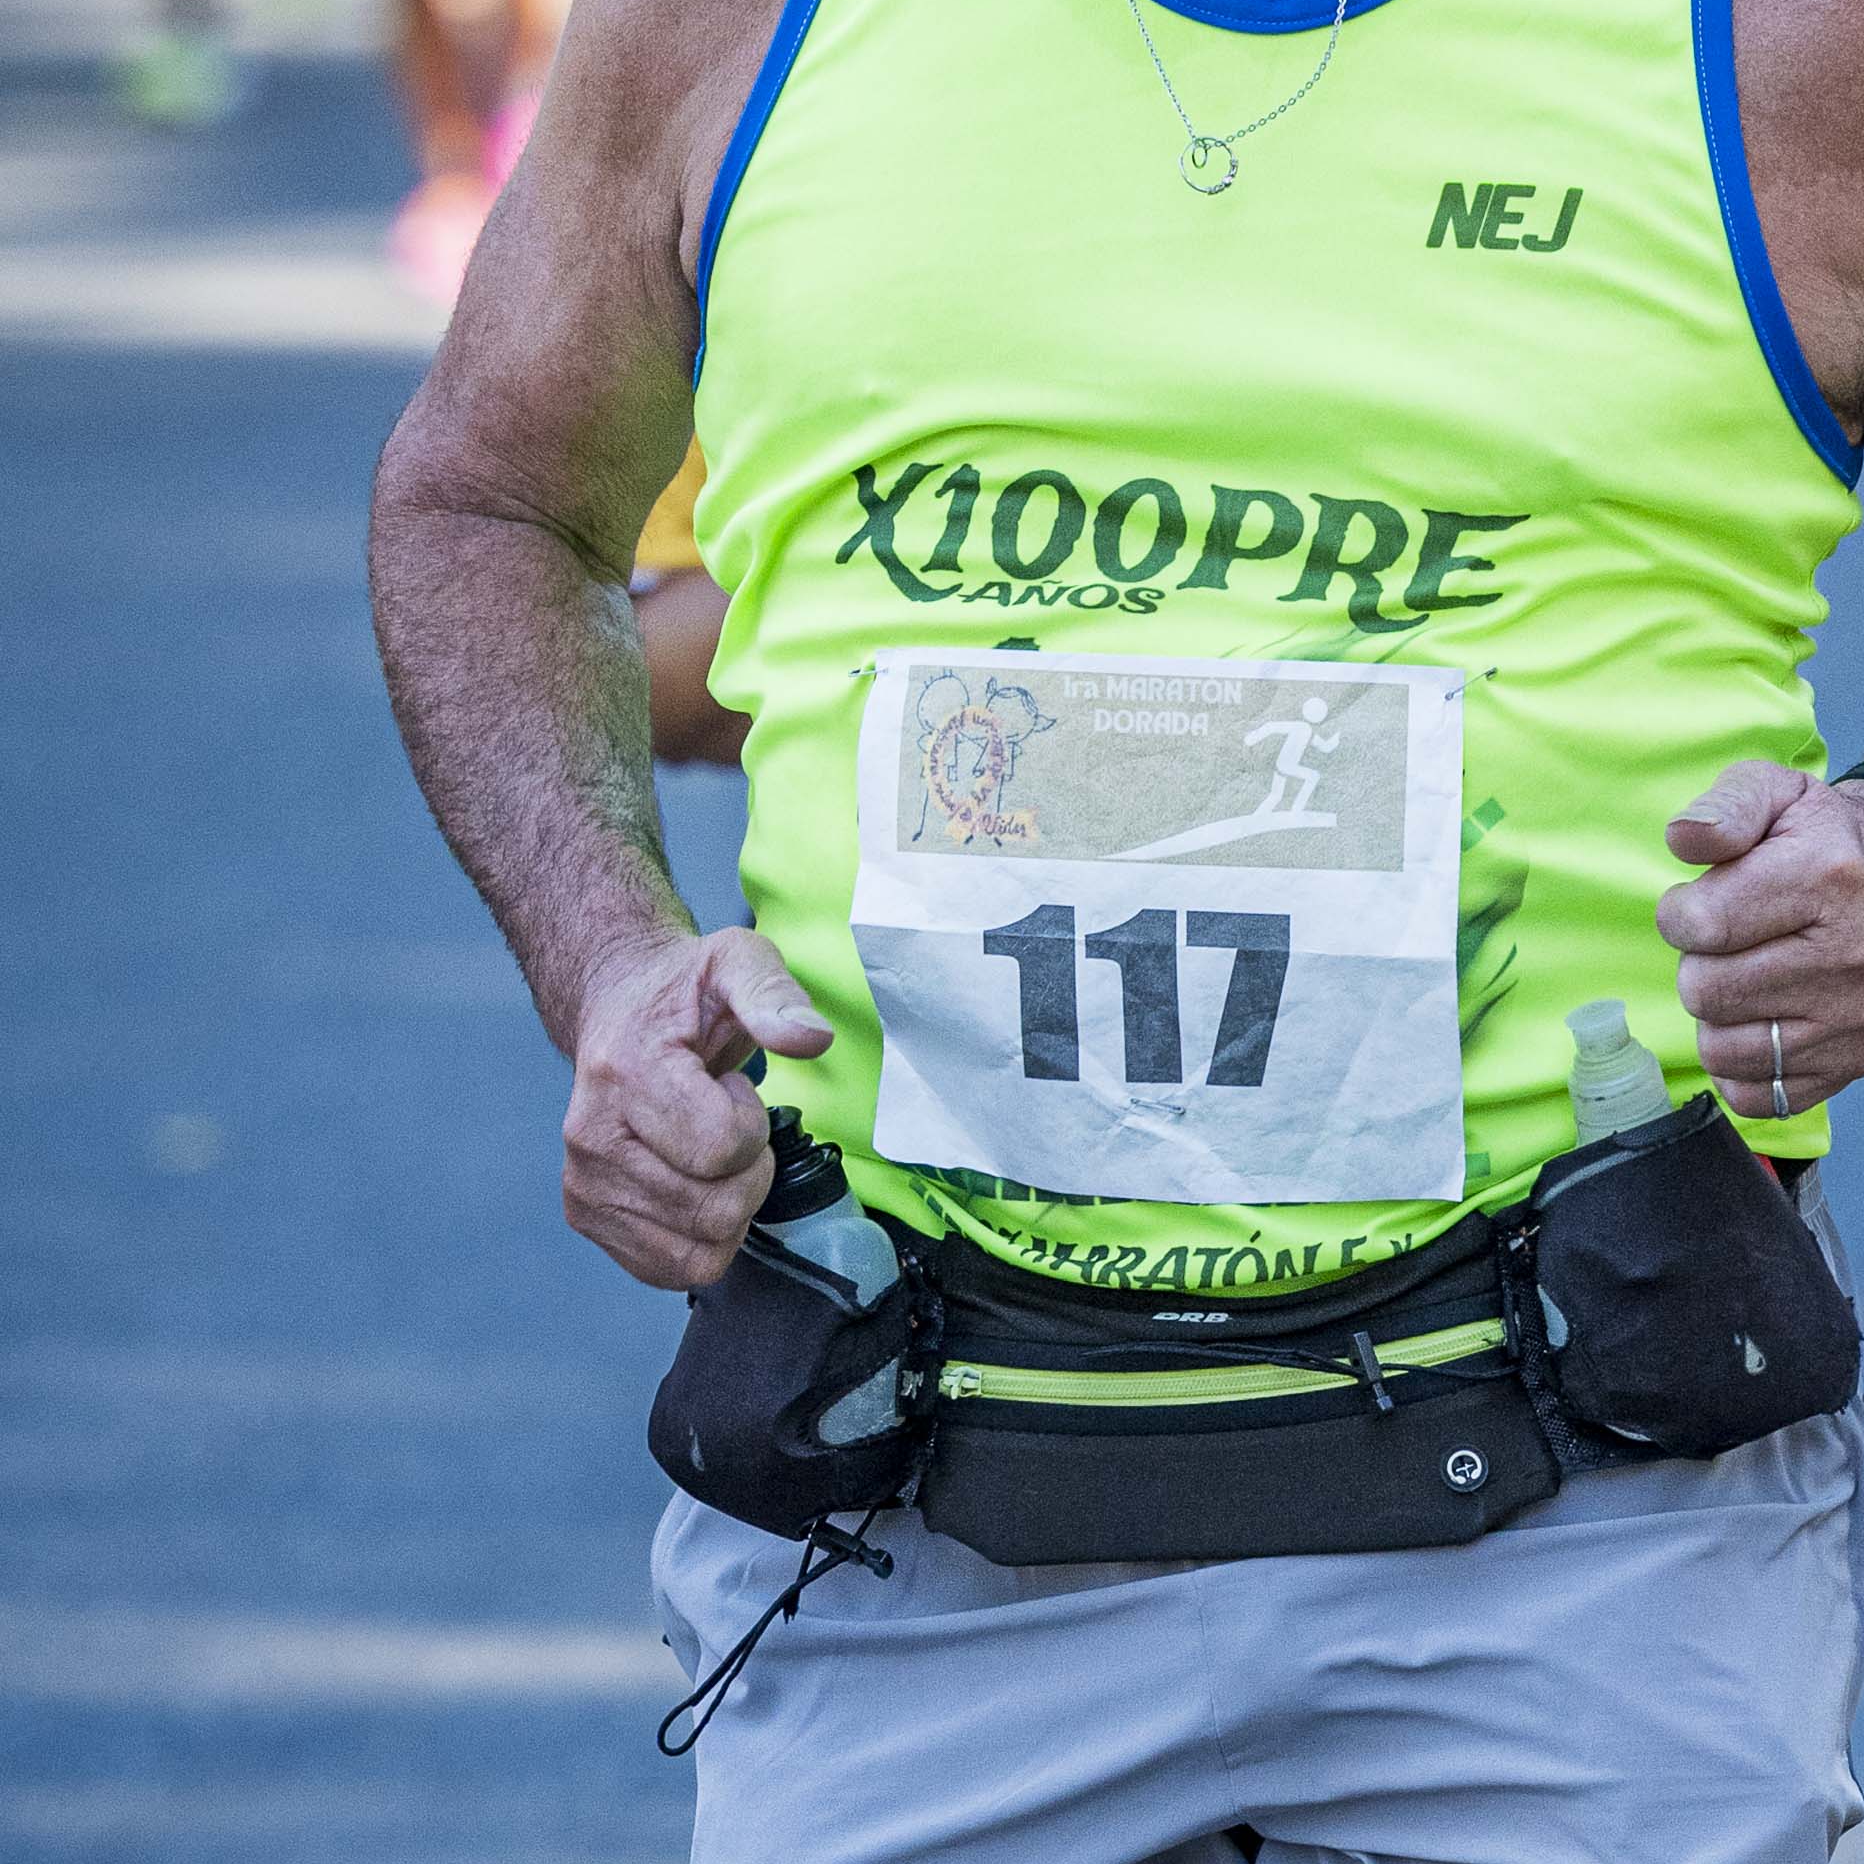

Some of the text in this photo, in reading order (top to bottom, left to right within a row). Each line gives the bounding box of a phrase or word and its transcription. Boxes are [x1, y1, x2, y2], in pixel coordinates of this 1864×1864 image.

[1426, 182, 1584, 253] NEJ
[835, 462, 1531, 634] X100PRE
[959, 578, 1166, 615] AÑOS
[1094, 708, 1209, 736] DORADA
[982, 903, 1291, 1087] 117
[1151, 1311, 1230, 1323] DRB
